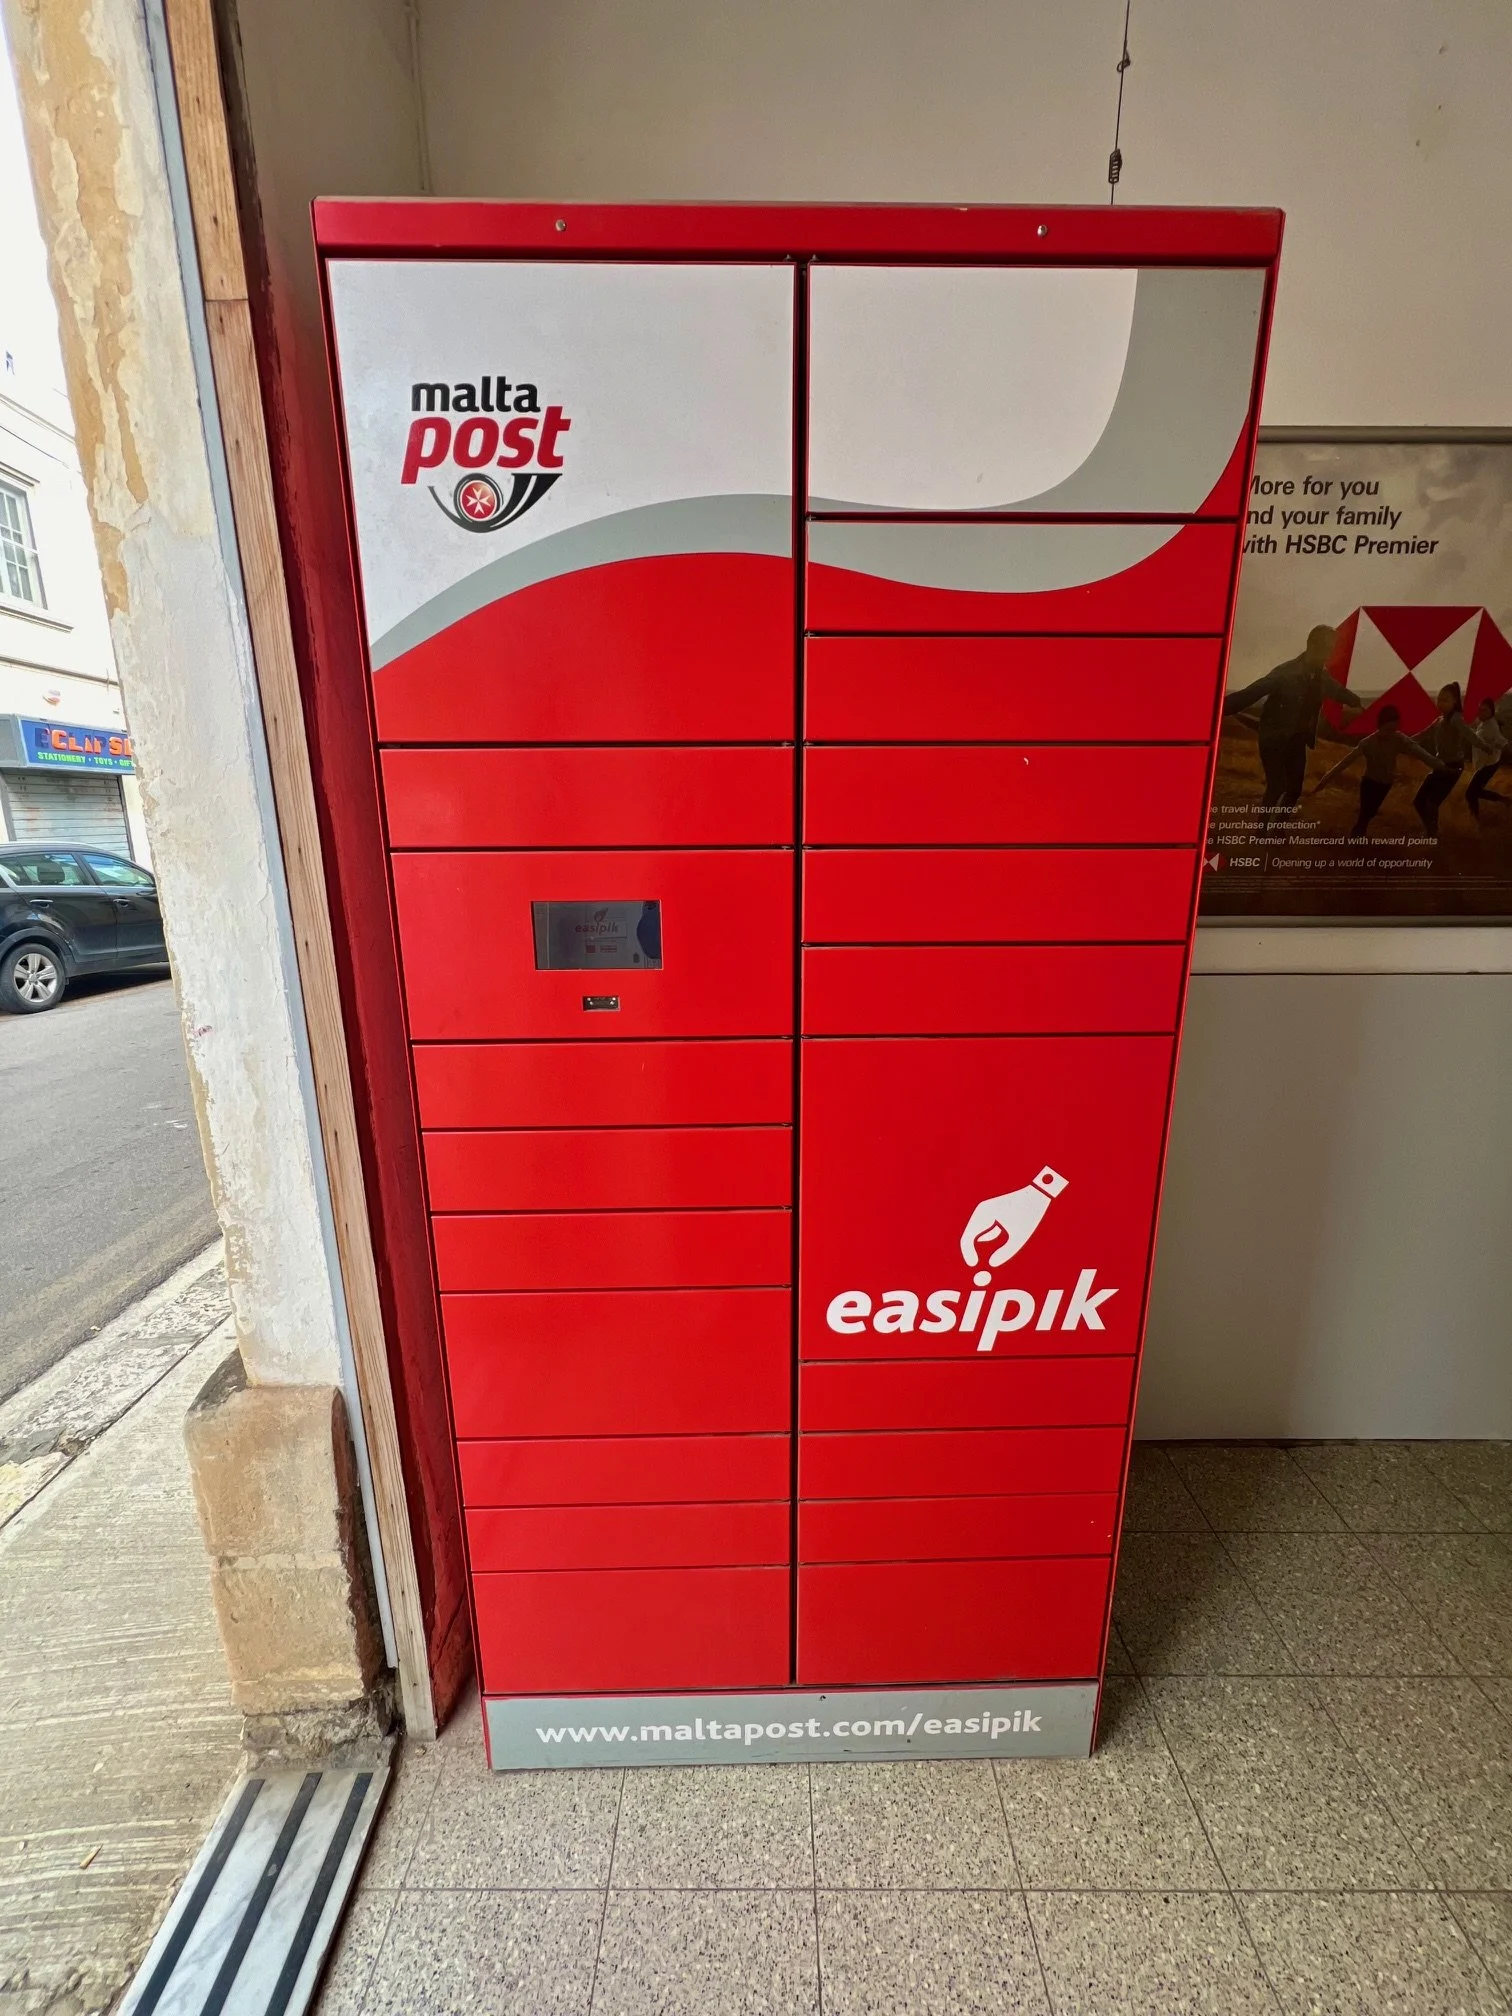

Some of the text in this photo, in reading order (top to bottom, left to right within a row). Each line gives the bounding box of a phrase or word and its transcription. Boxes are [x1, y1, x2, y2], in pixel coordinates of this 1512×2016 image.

[411, 376, 541, 413] malta
[401, 405, 572, 484] post
[1302, 475, 1333, 496] for
[1340, 479, 1380, 500] you
[1246, 505, 1402, 530] nd your family
[1285, 534, 1348, 555] HSBC
[1354, 534, 1439, 555] Premier
[37, 751, 86, 764] STATIONERY
[93, 756, 113, 766] TOYS
[1220, 804, 1249, 814] travel
[1218, 820, 1264, 831] purchase
[1216, 835, 1246, 845] HSBC
[1248, 835, 1287, 845] Premier
[1288, 835, 1345, 845] Mastercard
[1347, 835, 1369, 845] with
[1371, 835, 1406, 845] reward
[1407, 836, 1438, 847] points
[1229, 857, 1261, 867] HSBC
[1271, 857, 1312, 869] Opening
[1314, 859, 1327, 869] up
[1337, 858, 1364, 867] world
[1366, 858, 1378, 867] of
[1378, 858, 1433, 870] opportunity
[535, 1710, 1043, 1746] www.maltapost.com/easipik
